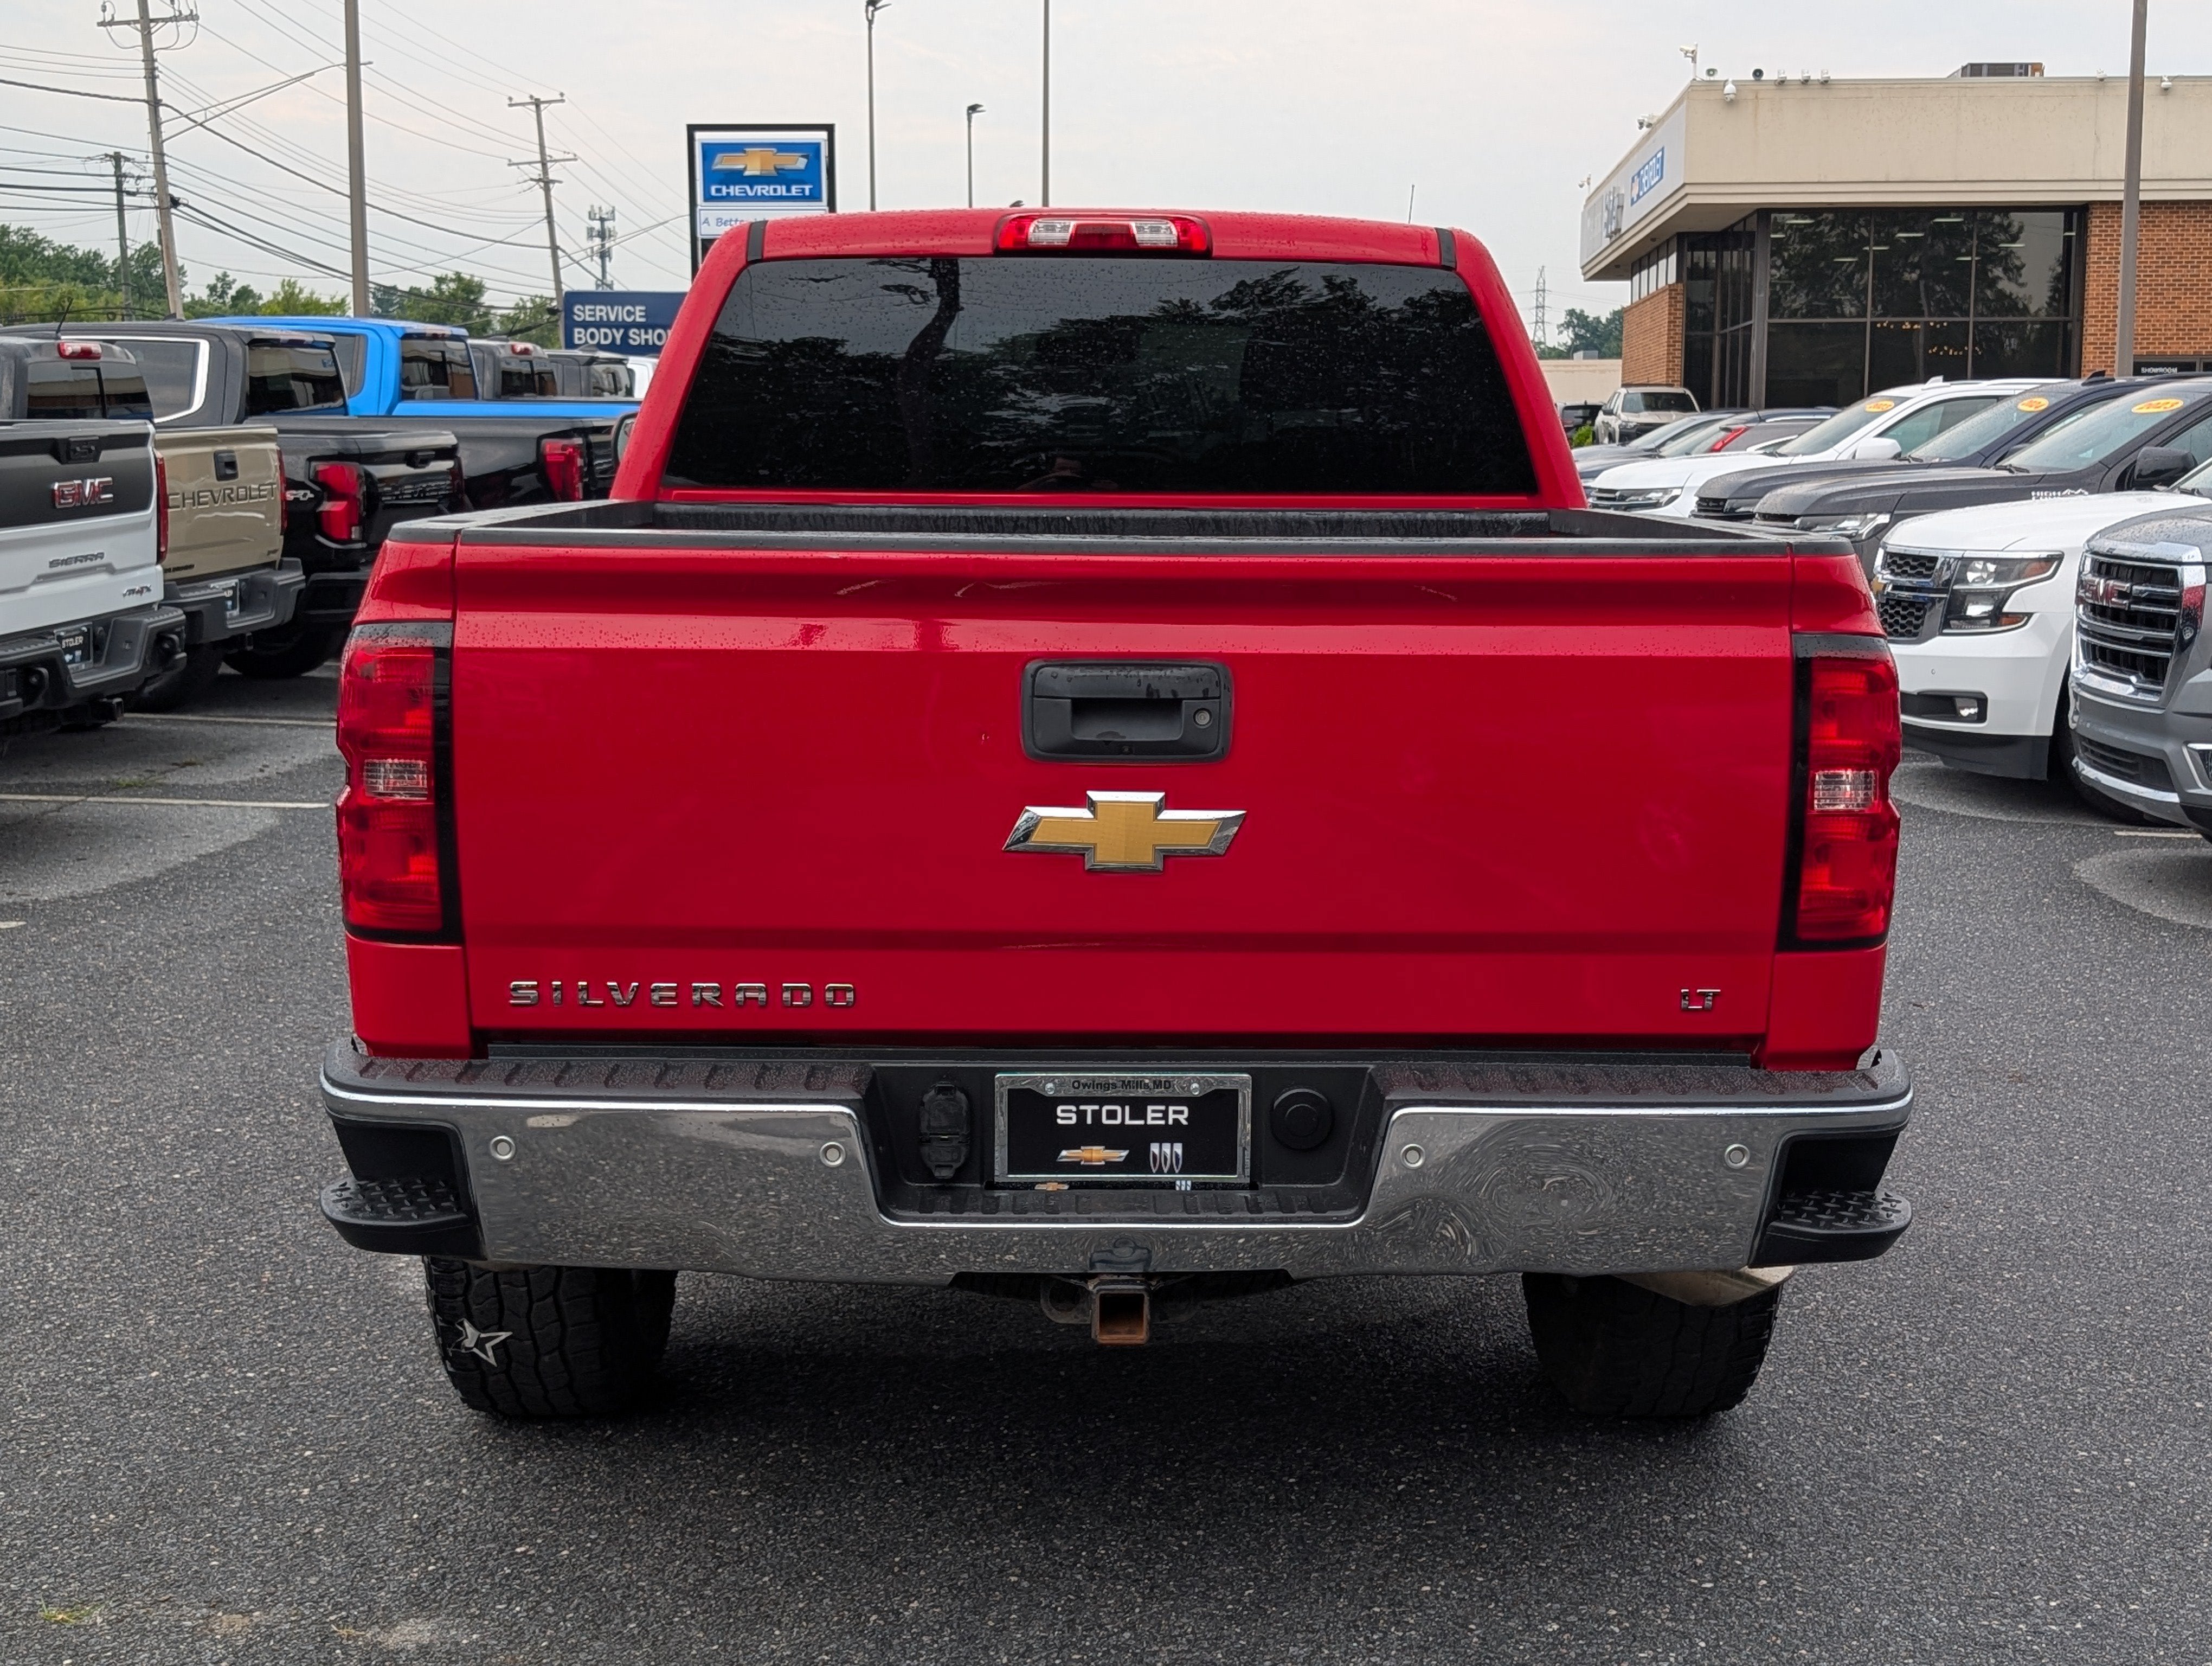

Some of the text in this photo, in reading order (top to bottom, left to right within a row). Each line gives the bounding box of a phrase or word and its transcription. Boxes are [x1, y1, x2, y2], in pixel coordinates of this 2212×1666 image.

[710, 185, 813, 196] CHEVROLET
[702, 217, 710, 226] A
[573, 305, 646, 322] SERVICE
[574, 328, 625, 345] BODY
[53, 477, 113, 509] GMC
[168, 482, 277, 511] CHEVROLET
[49, 552, 105, 568] SIERRA
[2078, 573, 2131, 611] GMC
[62, 636, 83, 649] STOLER
[509, 981, 855, 1007] SILVERADO
[1681, 989, 1721, 1010] LT
[1072, 1080, 1117, 1091] Owings
[1153, 1080, 1171, 1090] MD
[1056, 1105, 1189, 1125] STOLER
